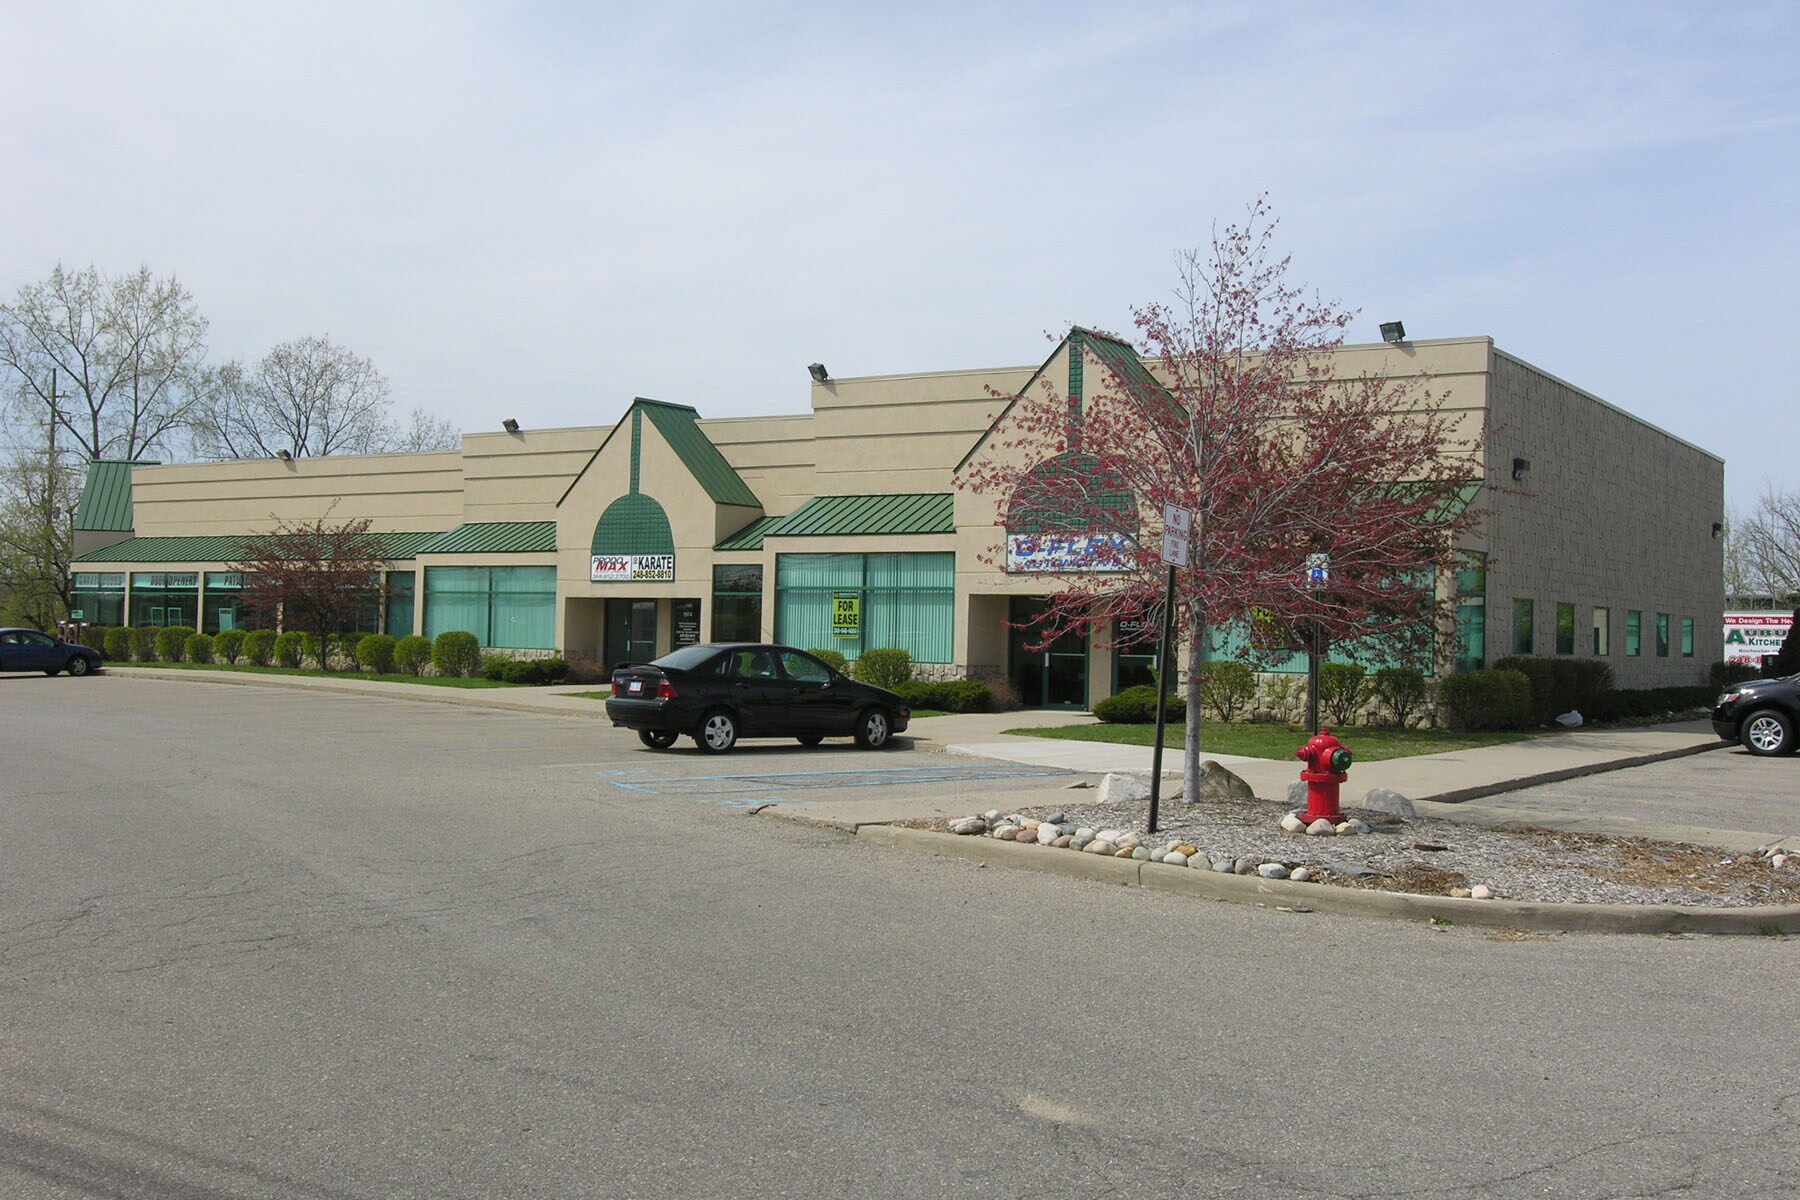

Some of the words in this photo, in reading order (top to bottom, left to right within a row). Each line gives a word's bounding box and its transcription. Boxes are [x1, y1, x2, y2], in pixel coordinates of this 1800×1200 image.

[1173, 513, 1181, 526] NO
[595, 560, 629, 572] MAX
[638, 556, 672, 570] KARATE
[633, 570, 672, 579] 248-852-8810
[838, 600, 854, 612] FOR
[833, 613, 858, 625] LEASE
[1726, 629, 1788, 645] AUBU
[1749, 638, 1781, 646] KITCHE
